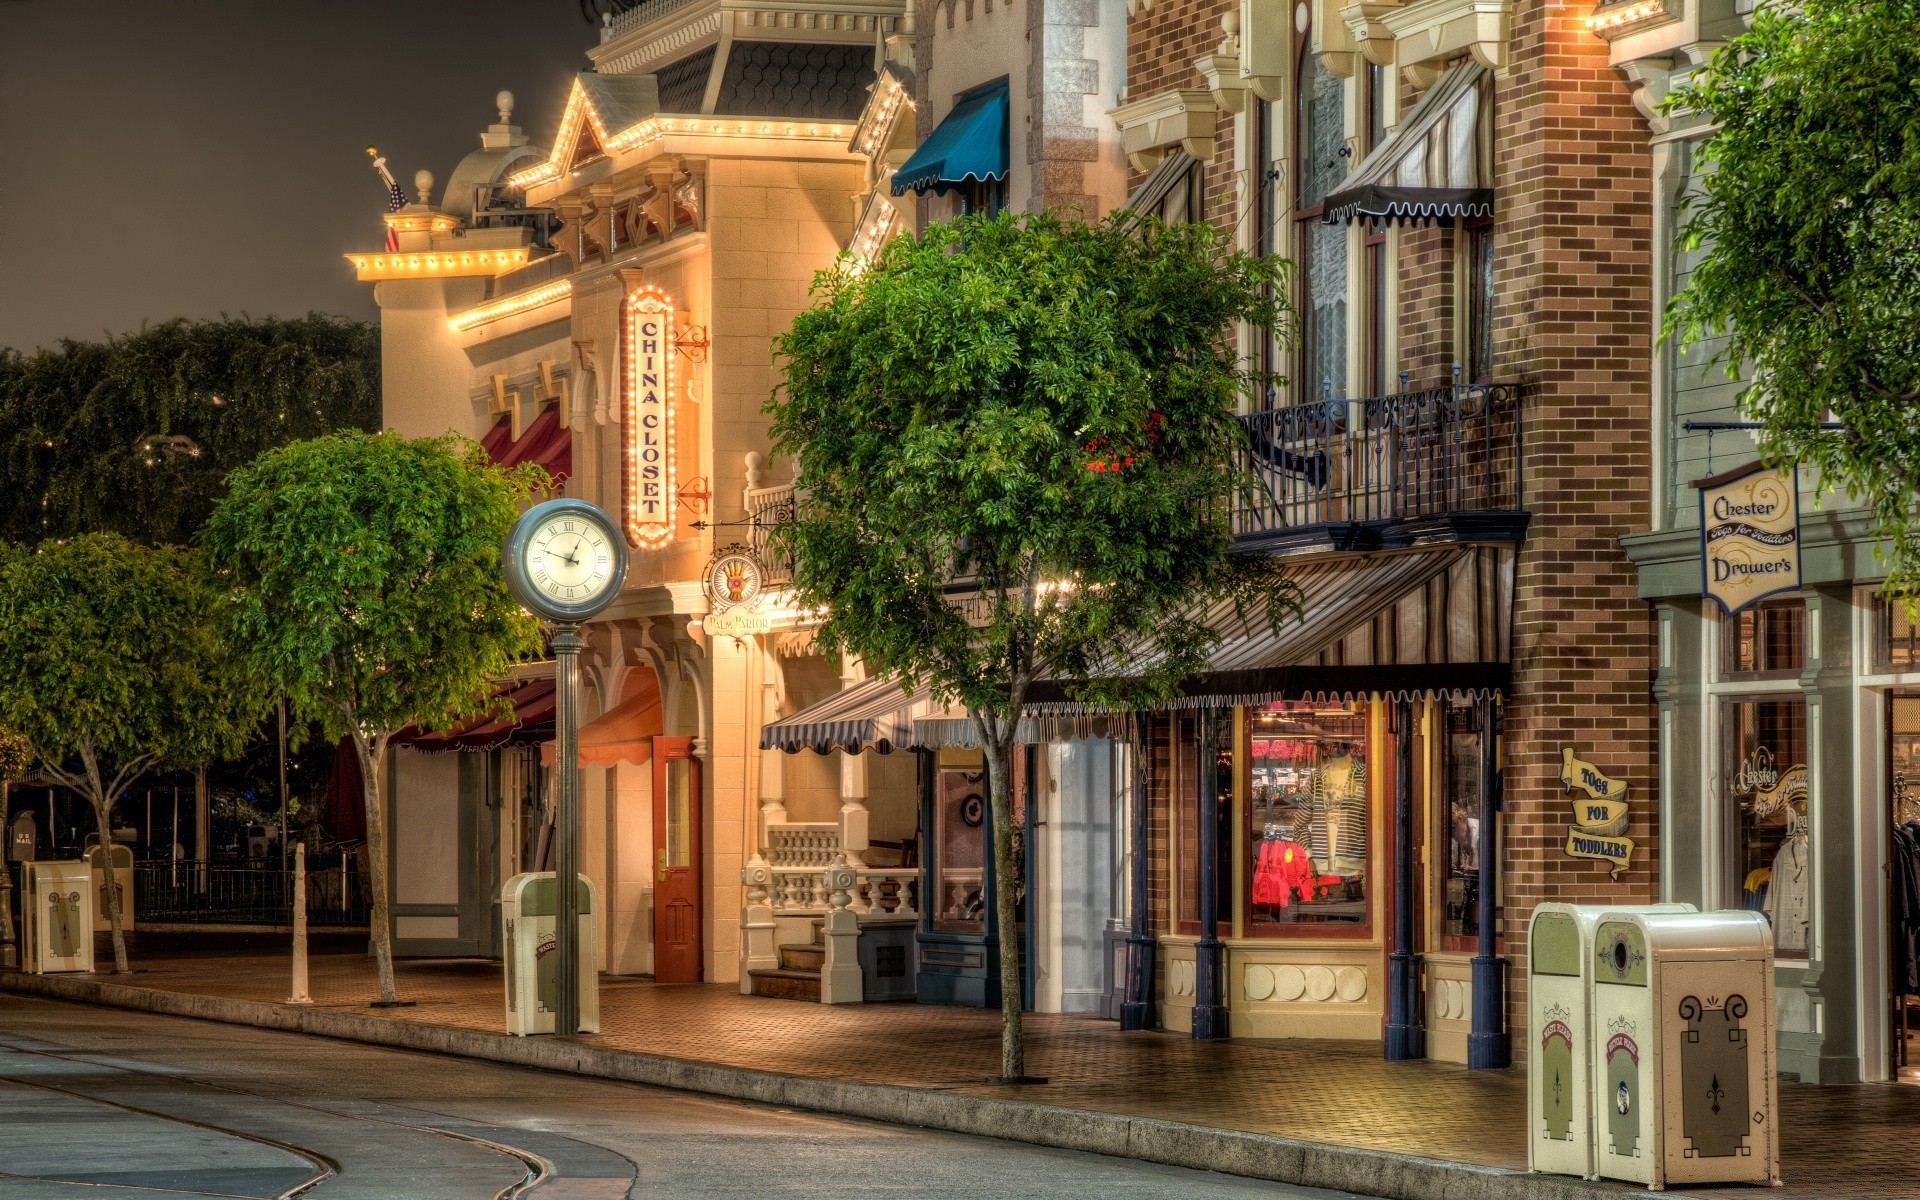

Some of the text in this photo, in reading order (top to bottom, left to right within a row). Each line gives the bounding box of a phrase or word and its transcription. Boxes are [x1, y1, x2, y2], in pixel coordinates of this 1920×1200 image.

[641, 322, 660, 514] CHINA CLOSET
[1713, 495, 1775, 521] Chester
[1711, 524, 1793, 543] Togs for Toddlers
[1712, 557, 1792, 582] Drawer's
[709, 616, 768, 630] PALM PARLOR
[1581, 768, 1608, 795] TOGS
[1740, 758, 1778, 791] Chester
[1586, 806, 1609, 820] FOR
[1572, 837, 1627, 858] TODDLERS
